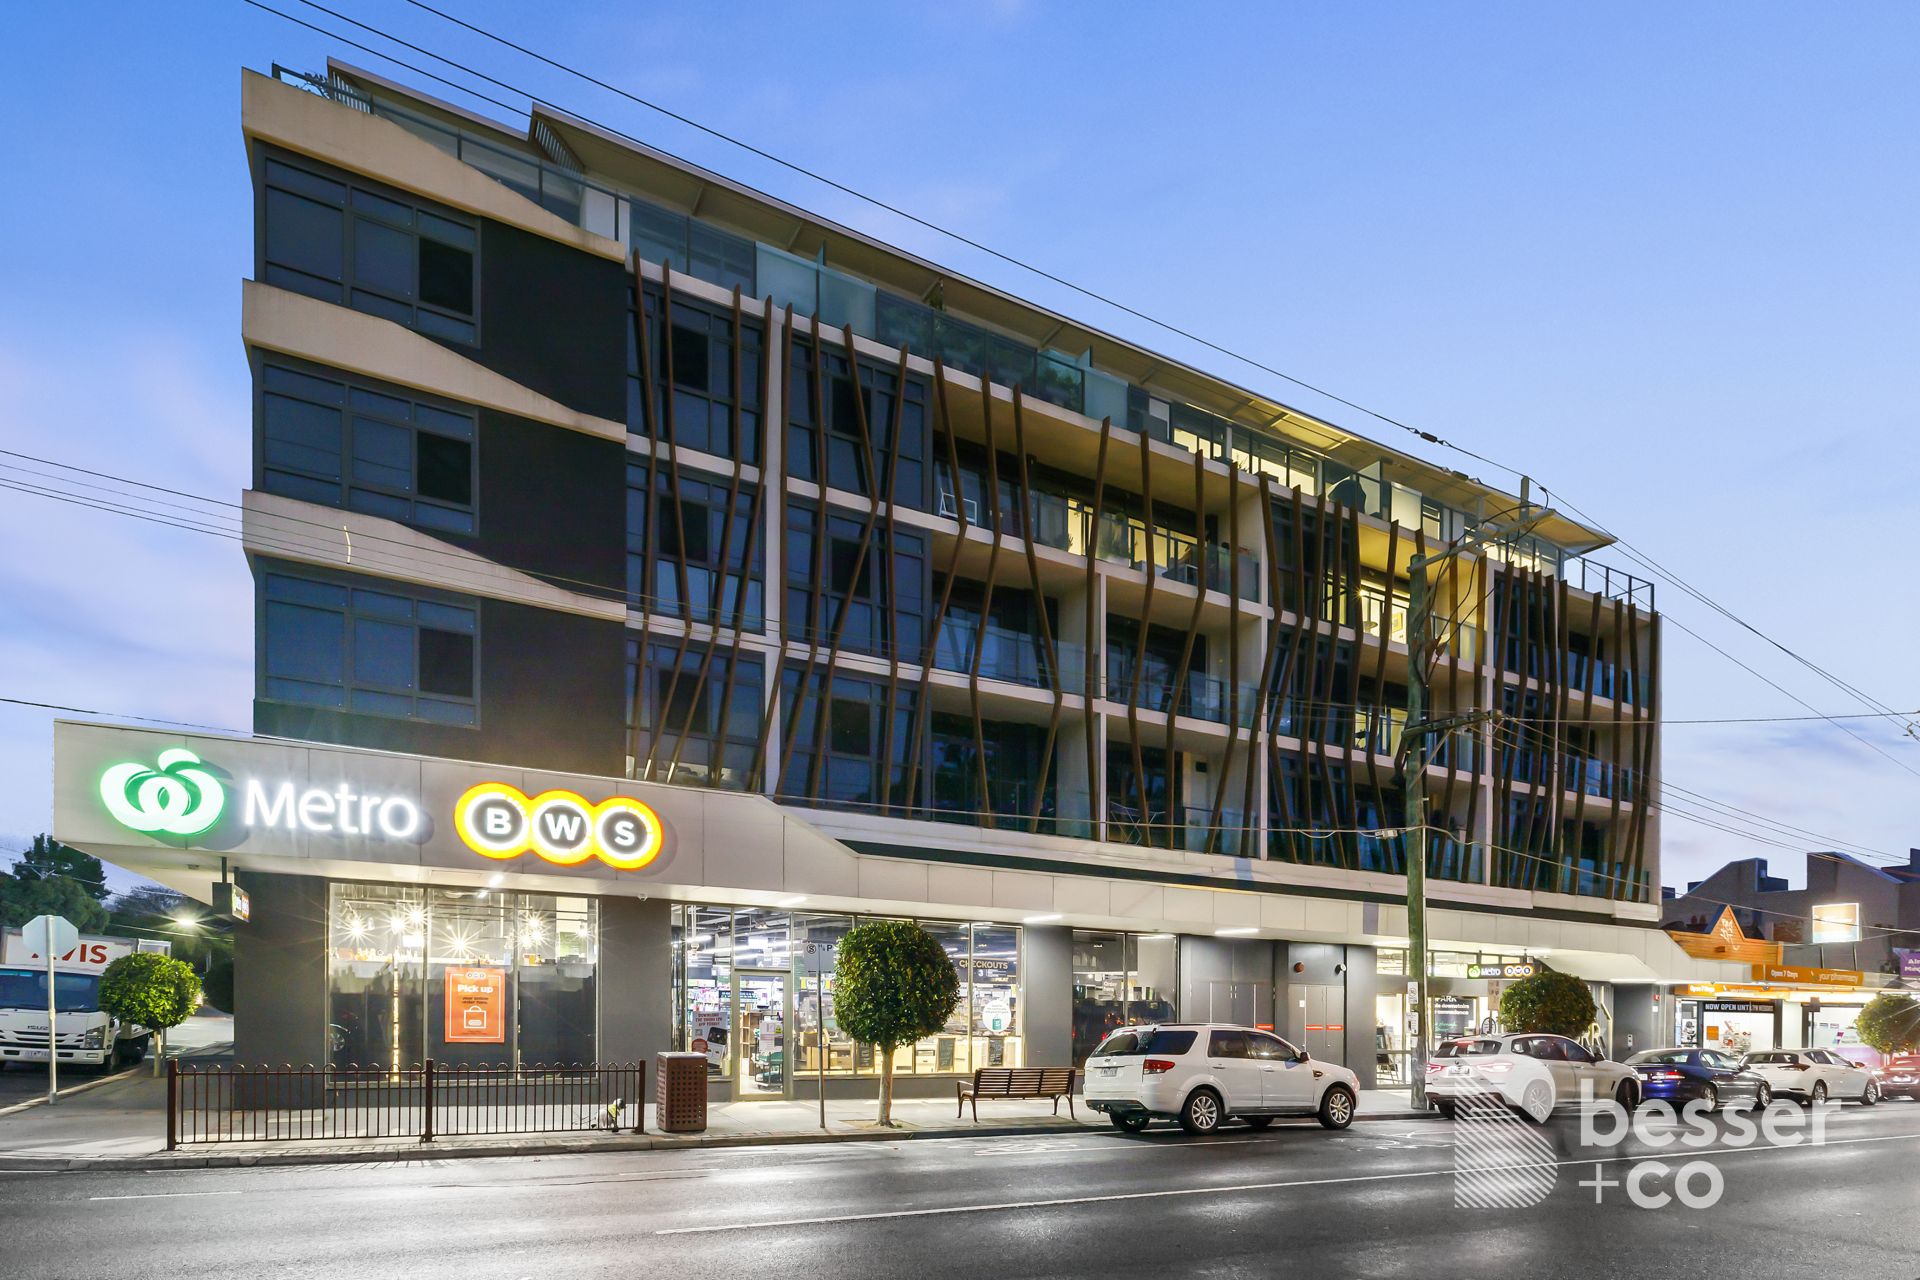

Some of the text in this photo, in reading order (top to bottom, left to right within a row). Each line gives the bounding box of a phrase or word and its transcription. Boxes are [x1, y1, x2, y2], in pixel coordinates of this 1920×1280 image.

[244, 779, 418, 837] Metro
[486, 807, 636, 847] BWS
[457, 984, 494, 994] Pick up
[1720, 1003, 1737, 1011] OPEN
